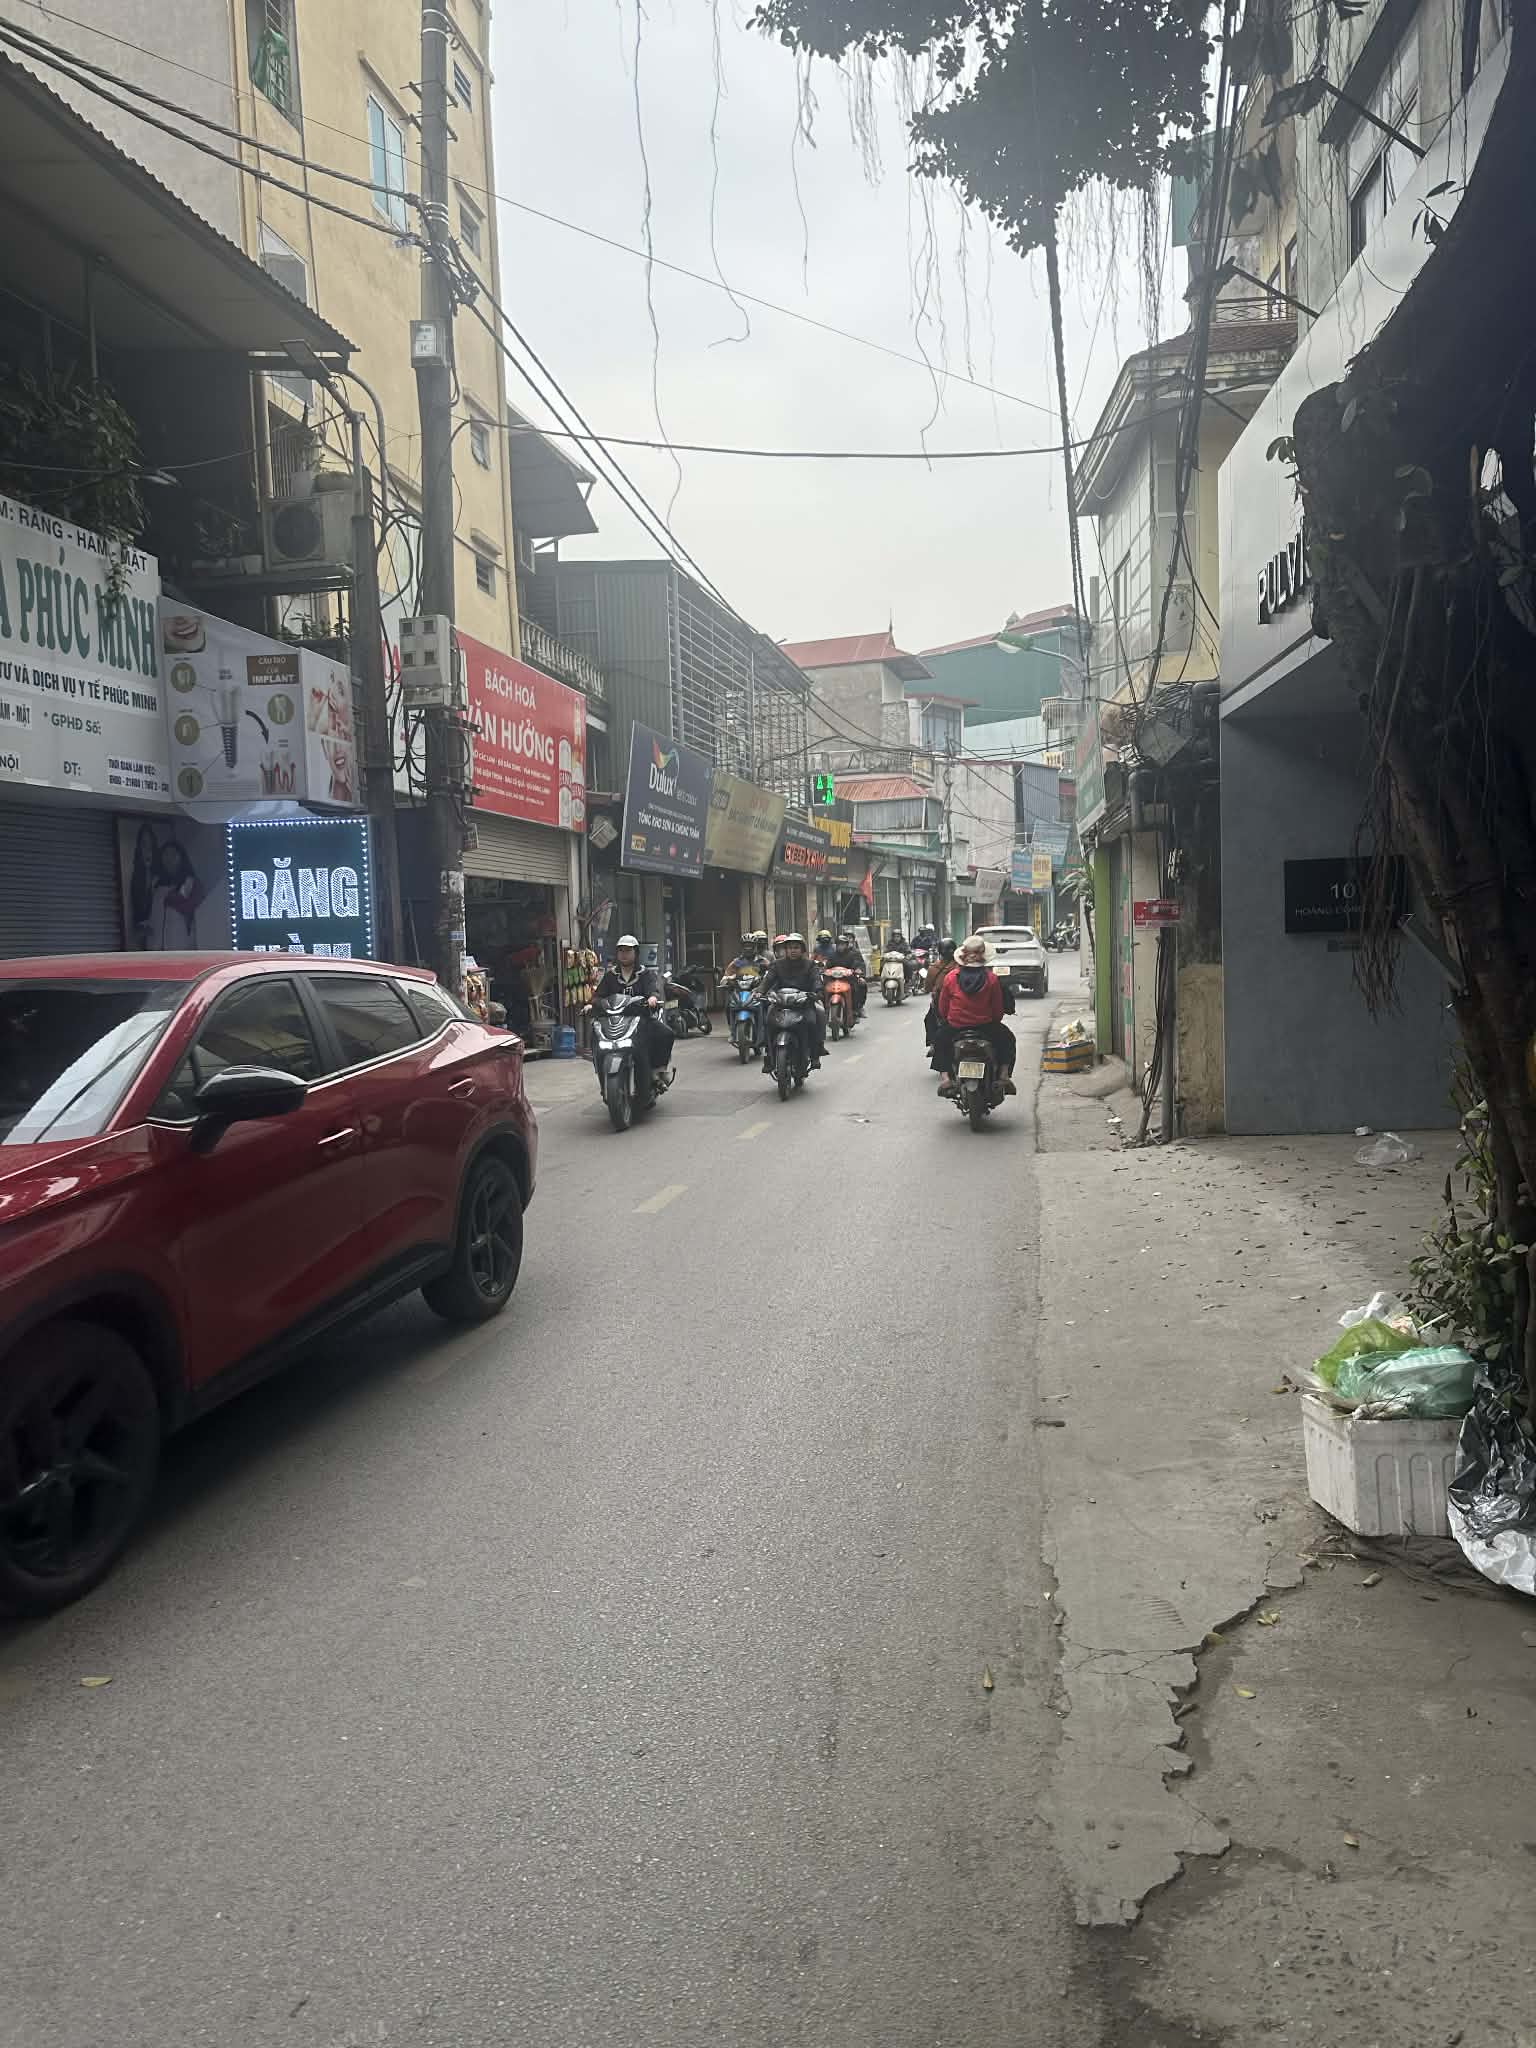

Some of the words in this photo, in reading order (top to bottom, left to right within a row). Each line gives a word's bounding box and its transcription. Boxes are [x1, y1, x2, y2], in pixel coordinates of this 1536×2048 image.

[16, 546, 90, 659] PHÚC
[95, 583, 157, 678] MINH
[14, 664, 30, 685] VÀ
[33, 669, 60, 692] DỊCH
[62, 676, 77, 698] VỤ
[78, 680, 86, 697] Y
[88, 679, 101, 700] TẾ
[103, 684, 130, 706] PHÚC
[131, 691, 158, 712] MINH
[252, 674, 296, 684] IMPLANT
[484, 668, 513, 700] BÁCH
[515, 685, 536, 710] HOÁ
[501, 719, 555, 765] HƯỞNG
[0, 754, 19, 772] NỘI
[64, 760, 81, 776] ĐT:
[649, 763, 674, 797] Dulux
[239, 856, 361, 920] RĂNG
[1329, 882, 1356, 900] 10
